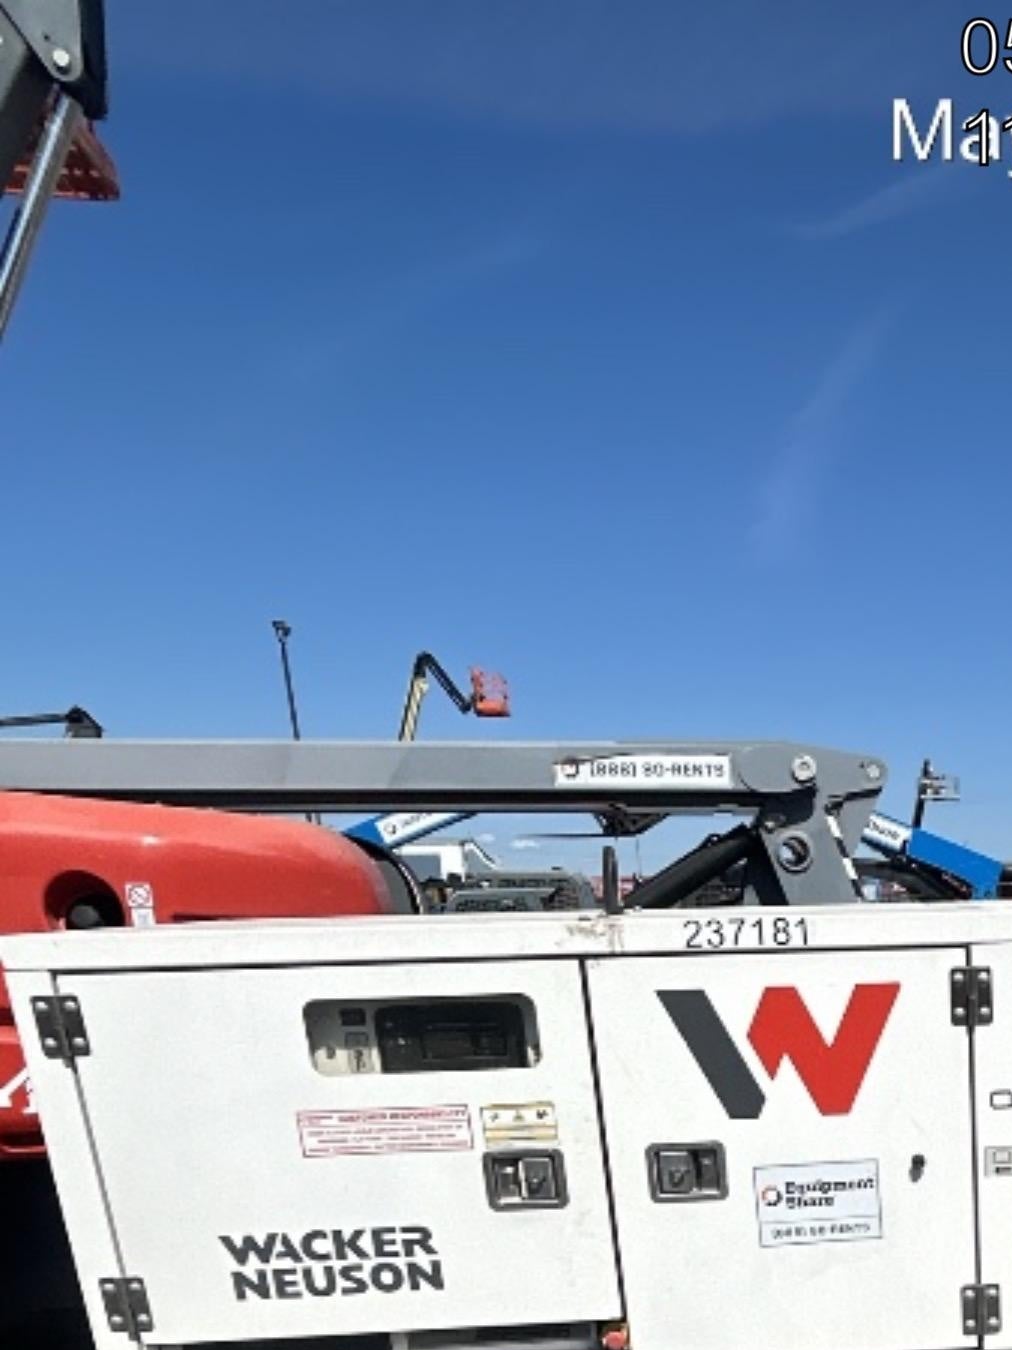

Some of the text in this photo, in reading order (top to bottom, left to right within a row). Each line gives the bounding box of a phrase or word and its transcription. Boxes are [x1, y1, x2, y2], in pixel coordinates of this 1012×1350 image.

[683, 917, 809, 949] 237181
[217, 1225, 439, 1267] WACKER
[230, 1259, 446, 1302] NEUSON
